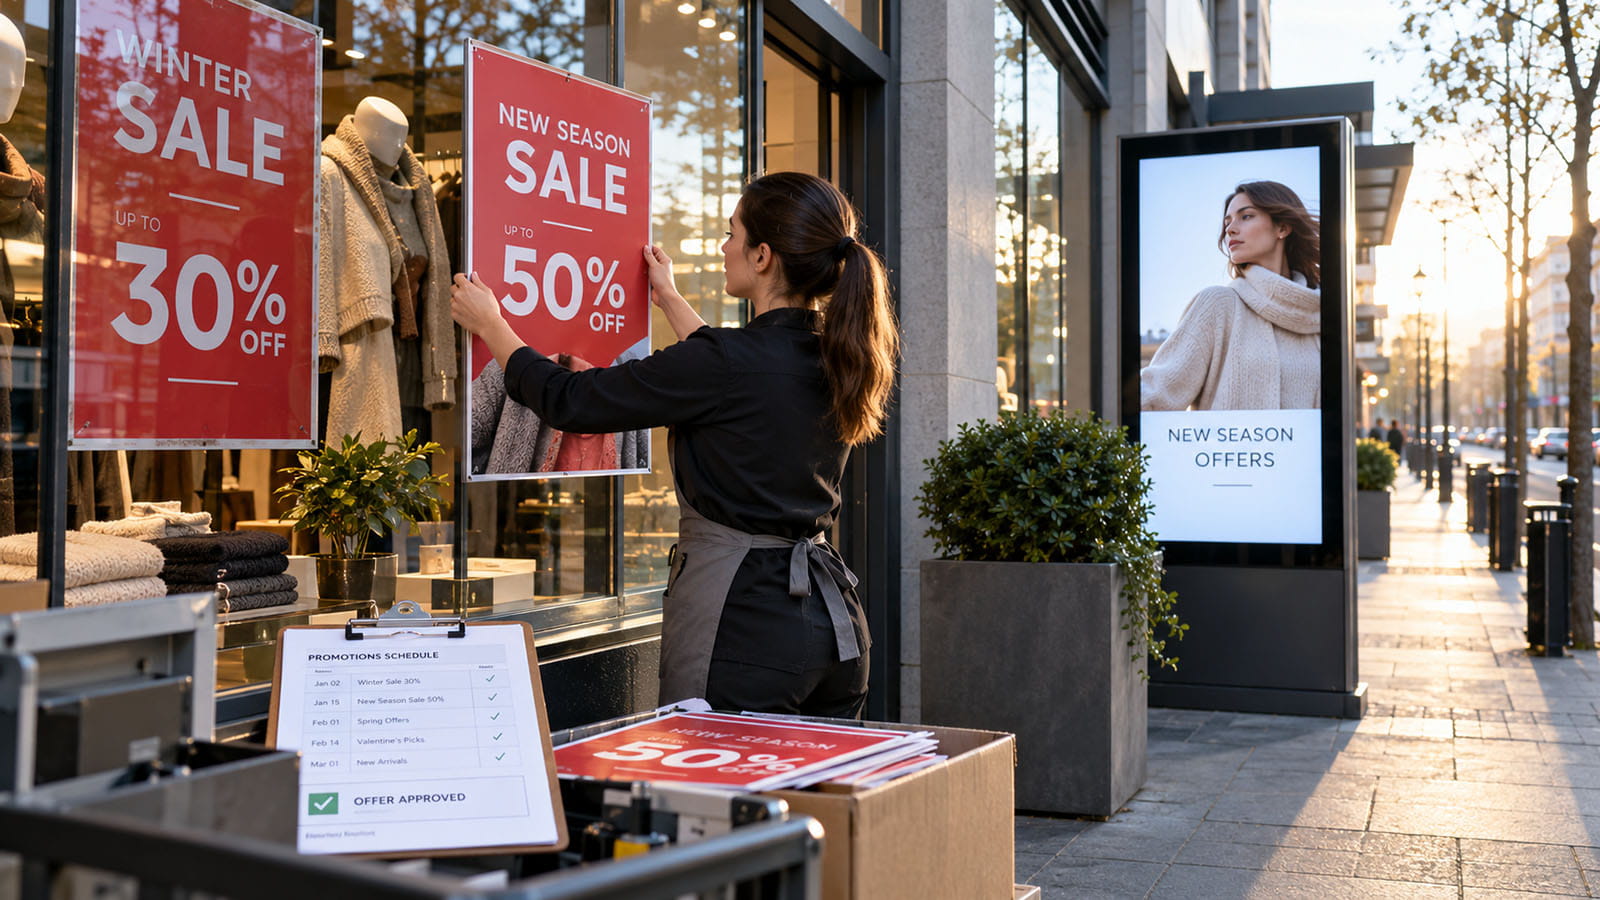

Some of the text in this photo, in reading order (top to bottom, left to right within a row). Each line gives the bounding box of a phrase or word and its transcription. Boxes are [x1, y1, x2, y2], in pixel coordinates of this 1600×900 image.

[116, 29, 252, 102] WINTER
[113, 81, 285, 187] SALE
[499, 102, 631, 159] NEW SEASON
[504, 139, 628, 215] SALE
[115, 210, 161, 232] UP TO
[504, 224, 534, 239] UP TO
[501, 244, 626, 321] 50%
[111, 241, 286, 351] 30%
[589, 311, 625, 334] OFF
[240, 329, 286, 357] OFF
[1168, 427, 1294, 442] NEW SEASON
[1195, 452, 1275, 467] OFFERS
[308, 651, 439, 662] PROMOTIONS SCHEDULE
[377, 697, 407, 705] Season
[357, 717, 384, 726] Spring
[357, 737, 402, 745] Valentine's
[735, 734, 837, 751] SEASON
[377, 758, 408, 766] Arrivals
[592, 740, 805, 772] 50%
[353, 792, 466, 806] OFFER APPROVED
